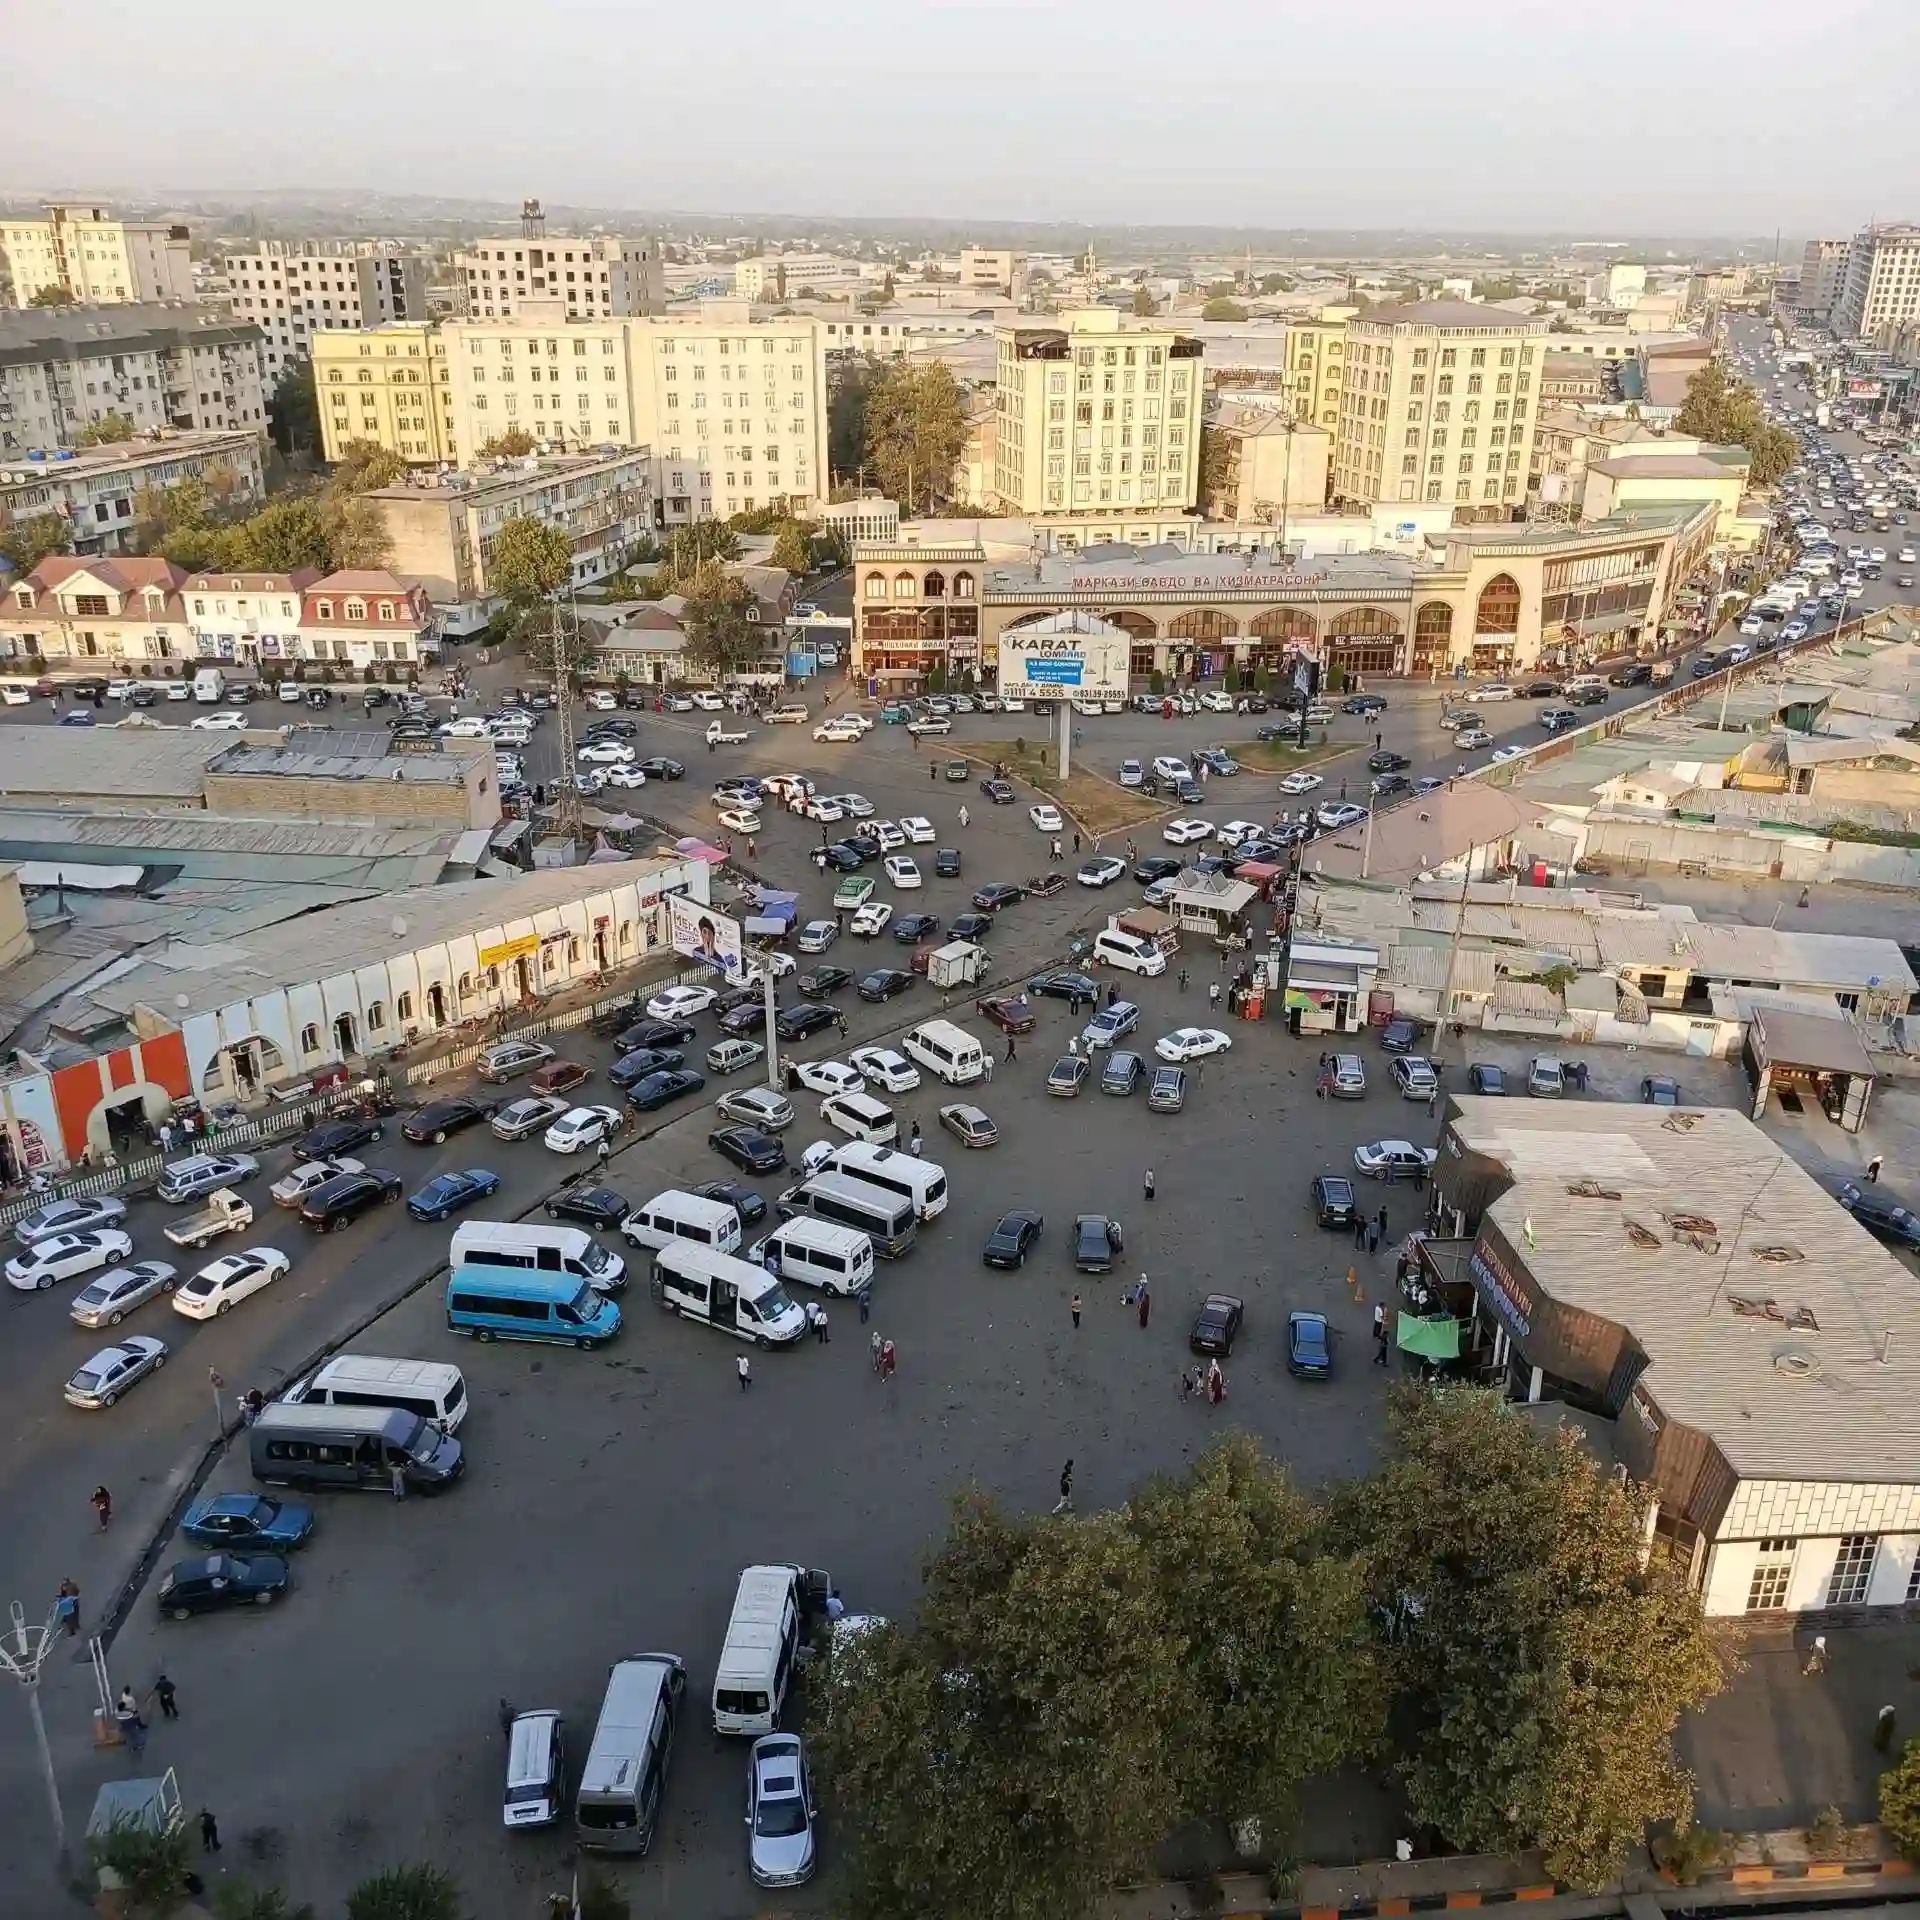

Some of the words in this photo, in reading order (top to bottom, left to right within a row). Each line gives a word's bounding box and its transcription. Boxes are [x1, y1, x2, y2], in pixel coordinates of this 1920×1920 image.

[1073, 577, 1135, 588] МАРКАЗИ
[1194, 576, 1210, 586] ВА
[1011, 639, 1082, 650] KARAT
[1040, 689, 1065, 697] 5555
